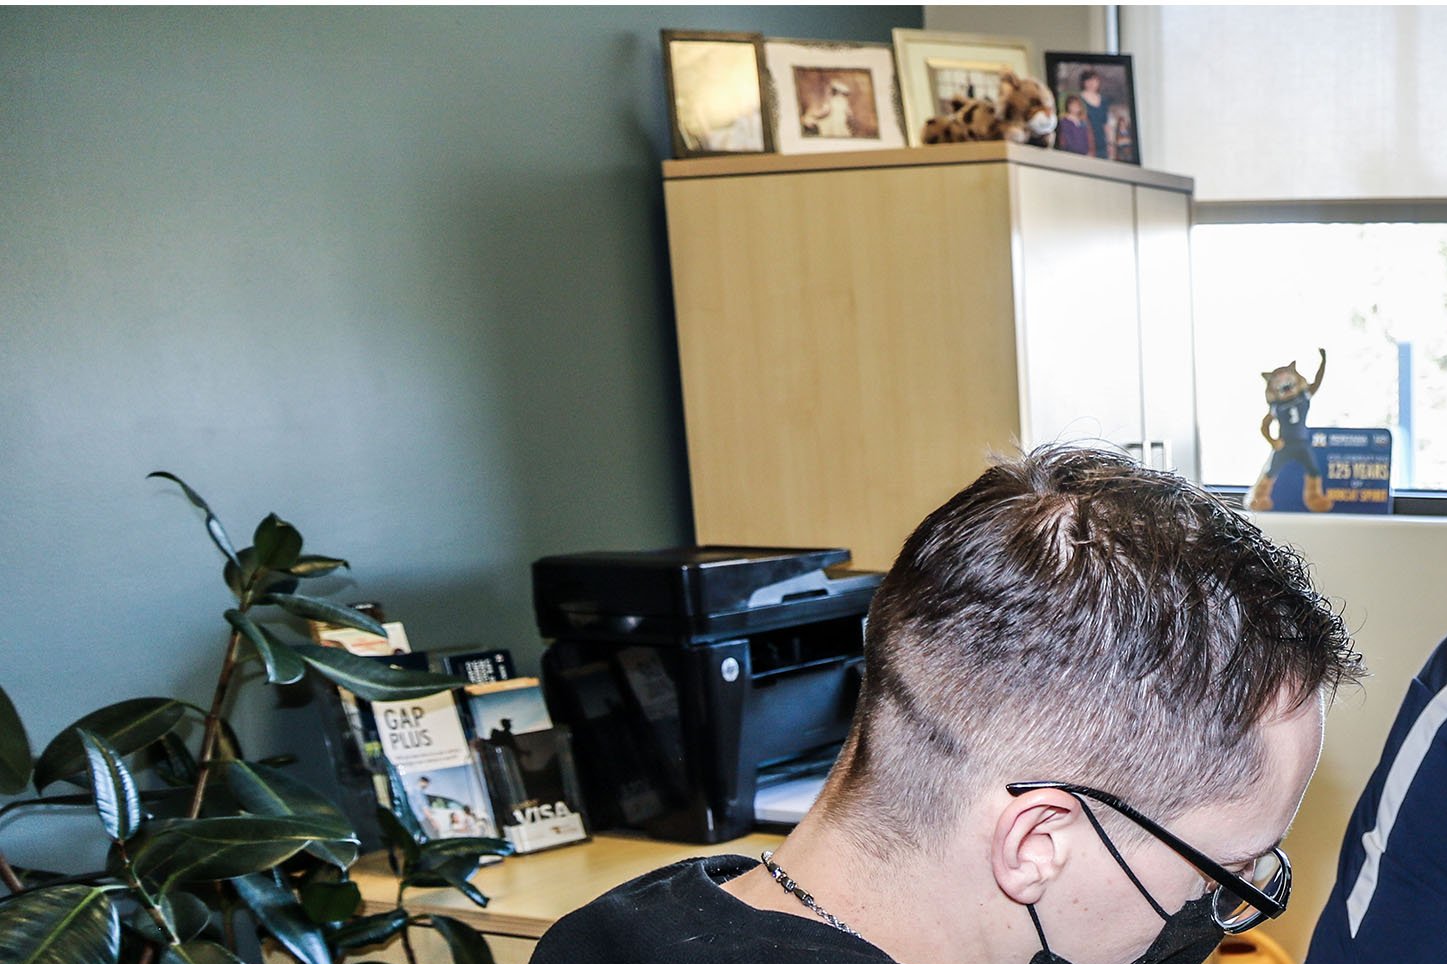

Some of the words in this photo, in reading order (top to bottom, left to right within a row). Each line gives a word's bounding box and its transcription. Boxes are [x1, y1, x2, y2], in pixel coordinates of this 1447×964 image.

[383, 706, 425, 731] GAP
[389, 729, 432, 751] PLUS
[512, 801, 572, 826] VISA
